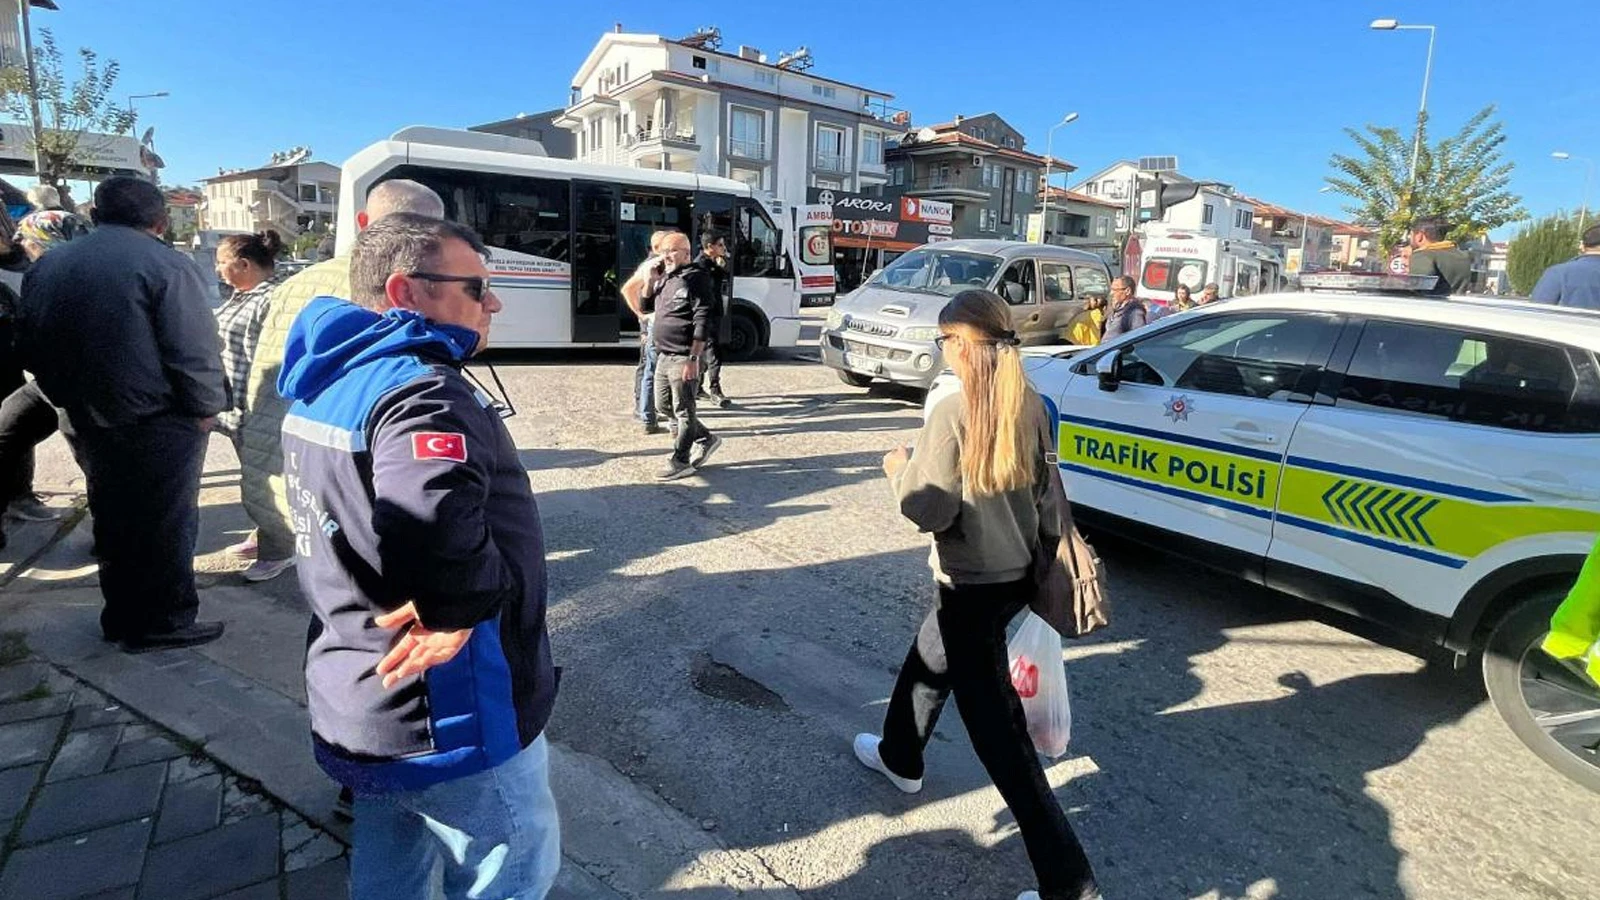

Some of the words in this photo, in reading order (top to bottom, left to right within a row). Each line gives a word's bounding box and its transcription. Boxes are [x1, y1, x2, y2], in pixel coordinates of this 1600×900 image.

[836, 197, 893, 213] ARORA
[1074, 435, 1159, 474] TRAFİK
[1168, 455, 1266, 499] POLİSİ
